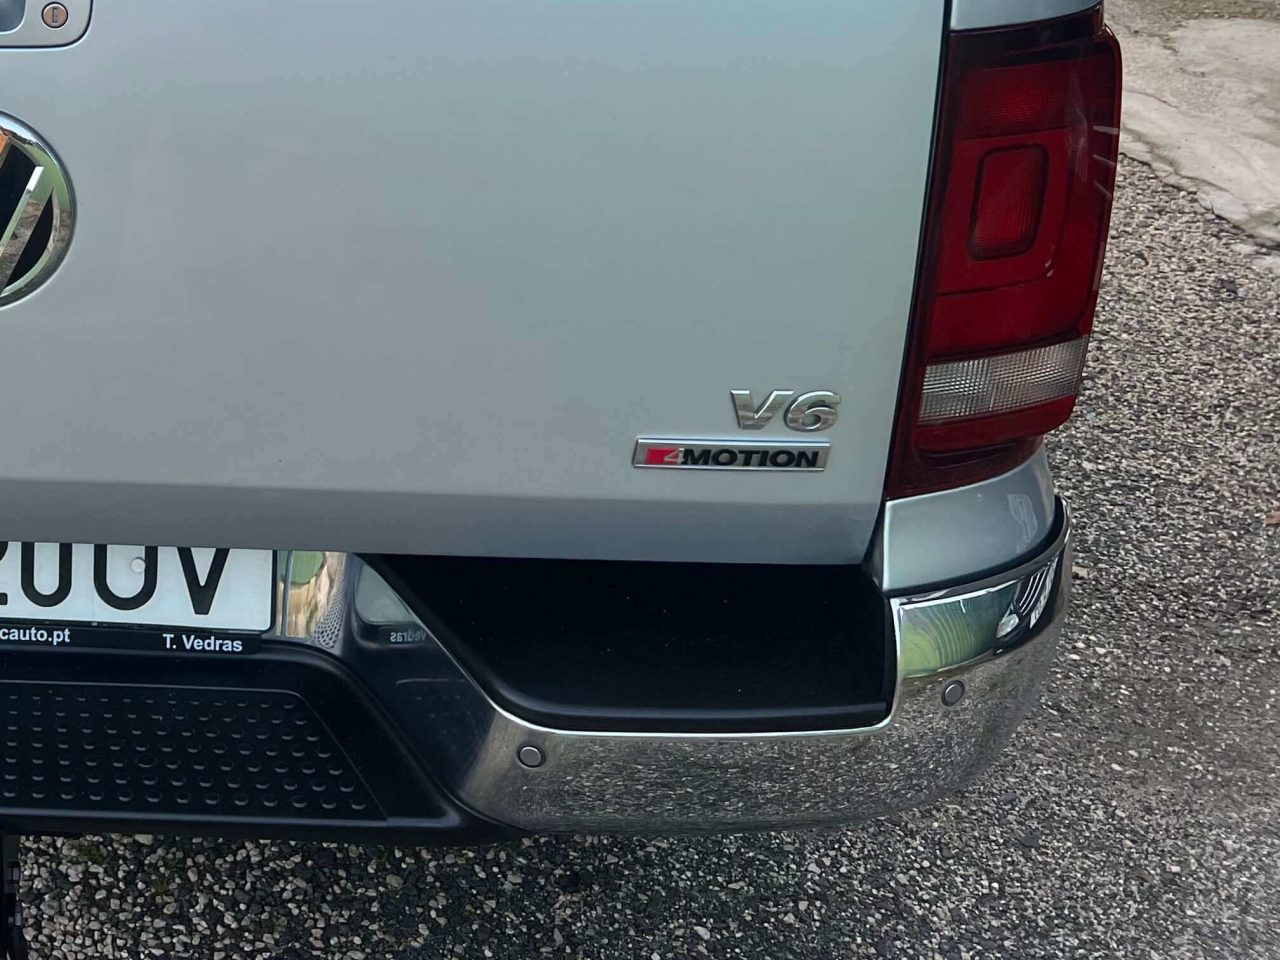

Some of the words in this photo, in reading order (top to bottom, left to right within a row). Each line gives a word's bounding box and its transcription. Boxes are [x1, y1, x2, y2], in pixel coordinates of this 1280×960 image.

[730, 389, 842, 432] V6
[163, 634, 177, 649] T.
[182, 634, 243, 652] Vedras
